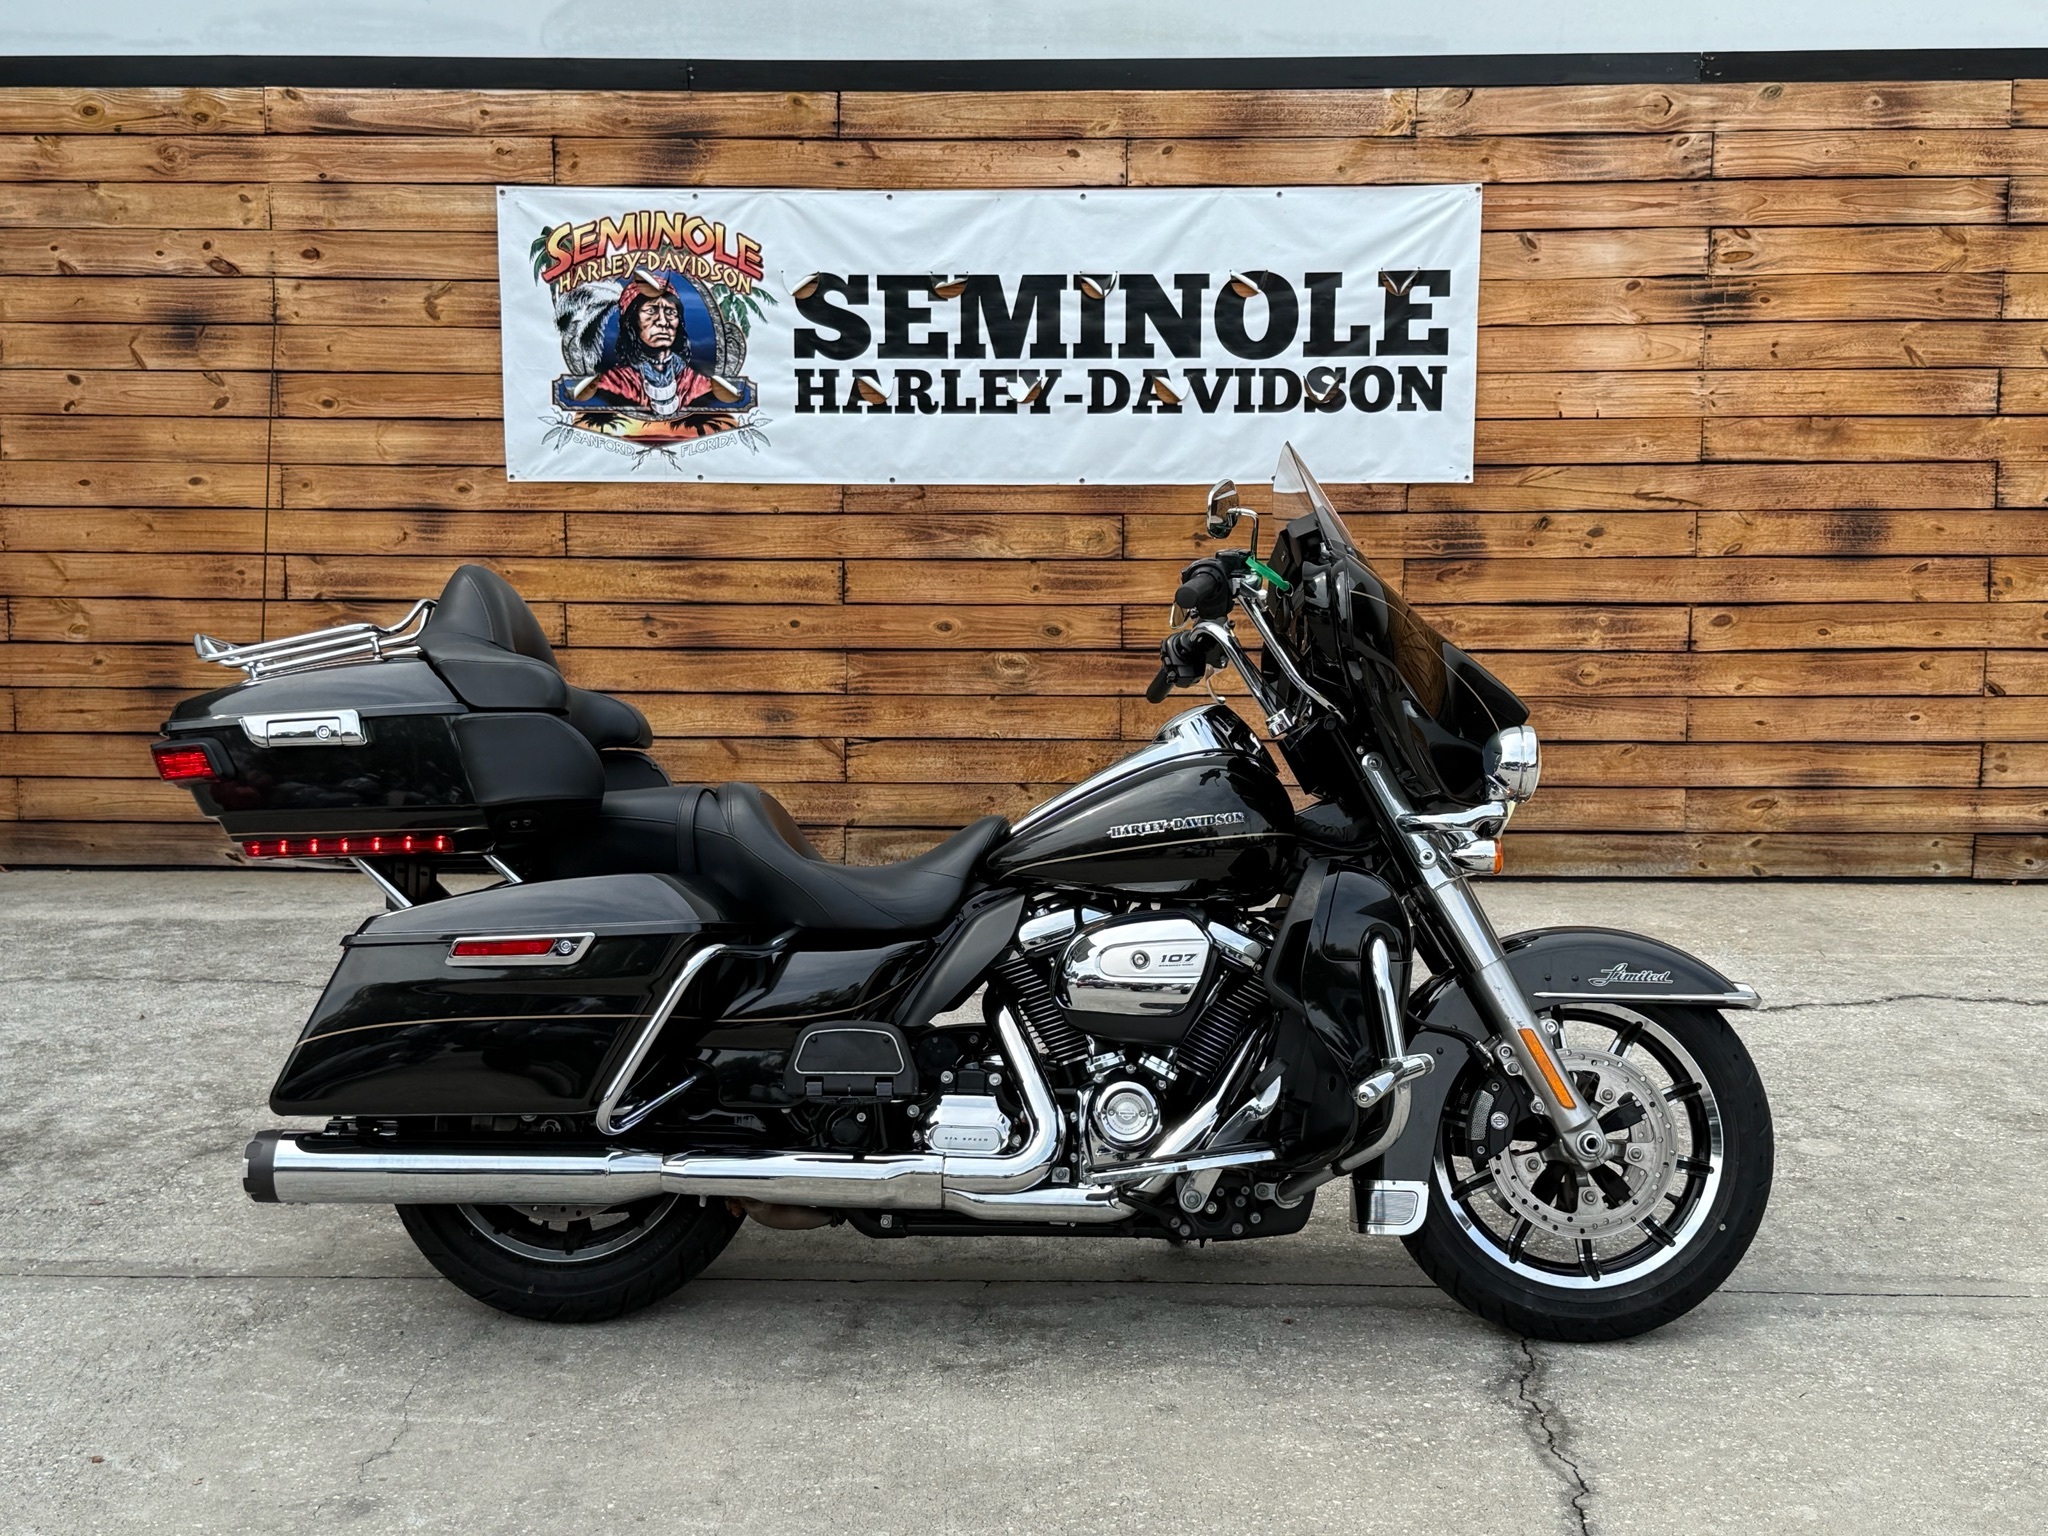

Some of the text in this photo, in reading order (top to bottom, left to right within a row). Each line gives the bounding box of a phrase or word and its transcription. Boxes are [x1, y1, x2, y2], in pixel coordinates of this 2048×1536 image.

[542, 210, 764, 283] SEMINOLE
[558, 251, 753, 294] HARLEY-DAVIDSON
[794, 269, 1451, 360] SEMINOLE
[794, 365, 1448, 414] HARLEY-DAVIDSON
[572, 431, 738, 460] SANFORD, FLORIDA
[1160, 953, 1198, 963] 107
[1588, 963, 1674, 987] Limited
